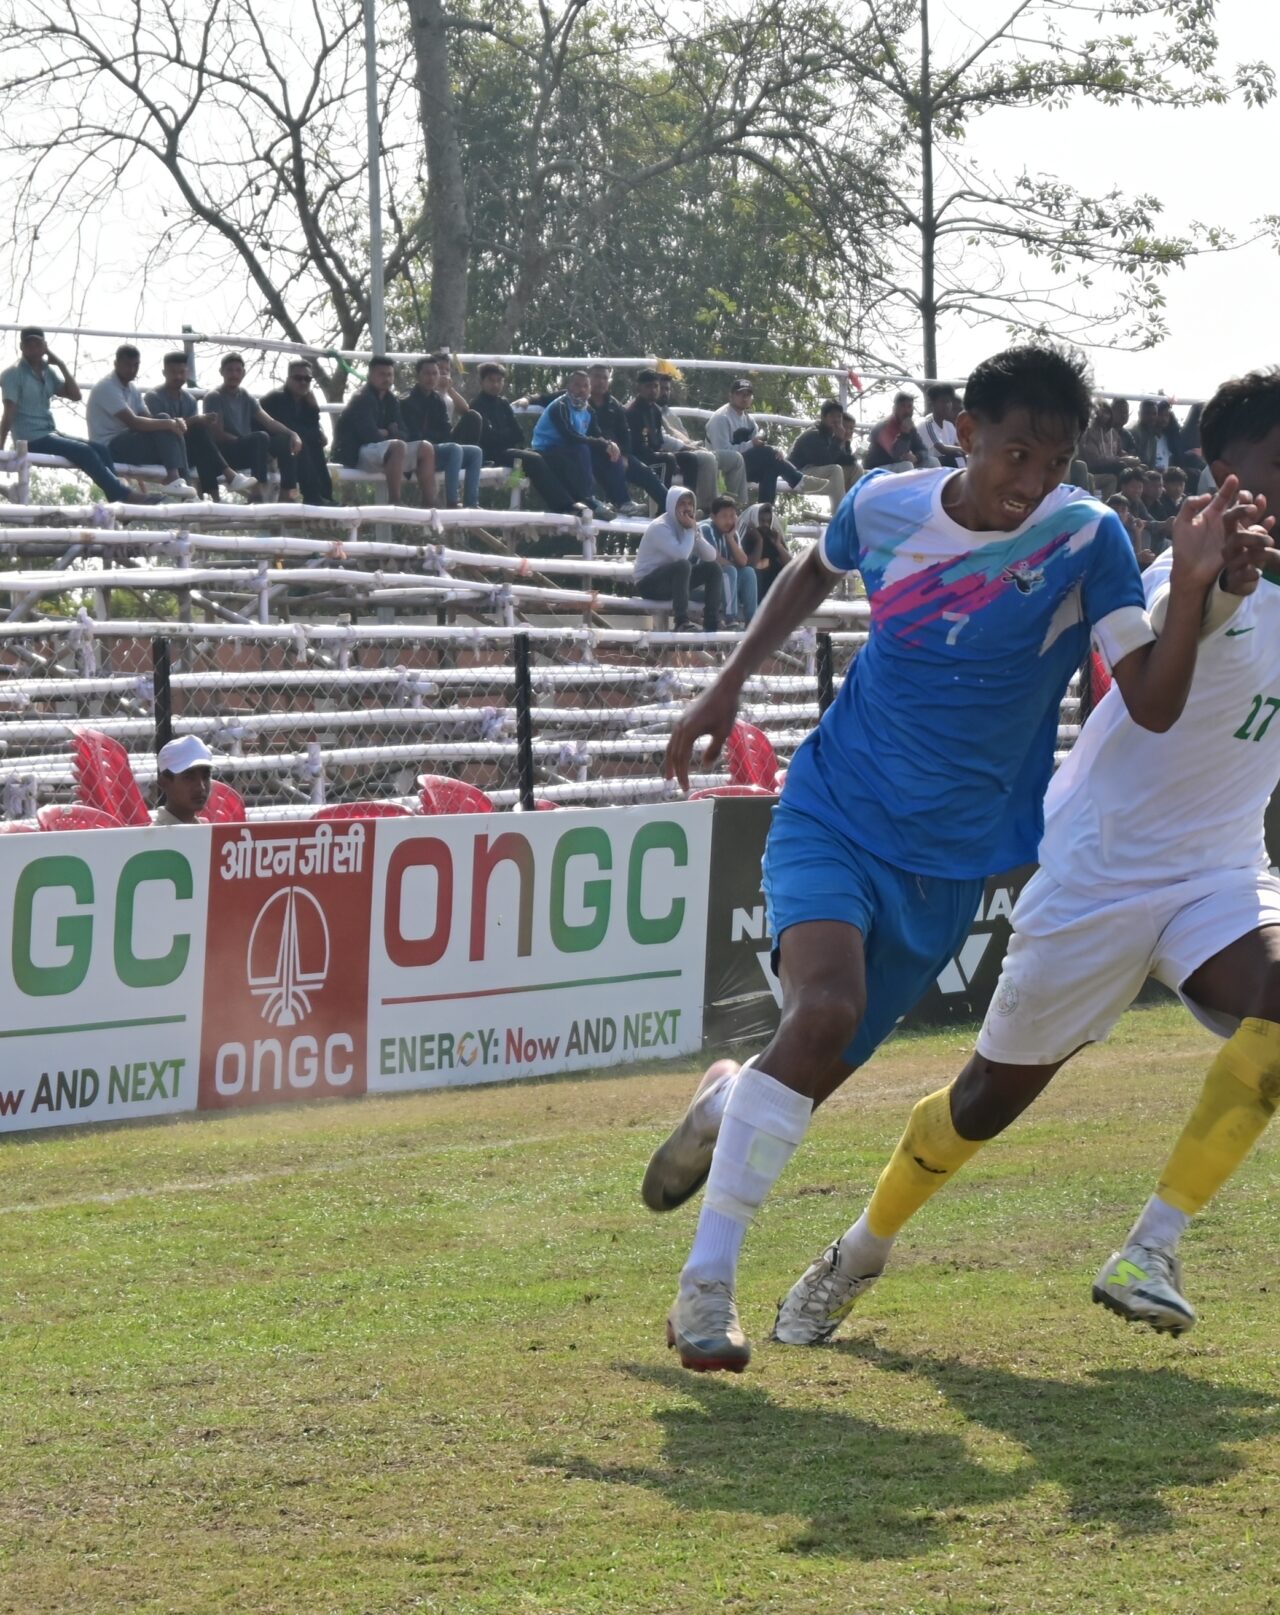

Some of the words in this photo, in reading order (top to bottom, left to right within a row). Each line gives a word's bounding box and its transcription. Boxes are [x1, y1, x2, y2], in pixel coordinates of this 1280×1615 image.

[942, 611, 970, 646] 7
[379, 1028, 499, 1075] ENERGY:
[564, 1016, 617, 1057] AND
[623, 1009, 682, 1050] NEXT
[30, 1068, 99, 1113] AND
[108, 1058, 186, 1105] NEXT
